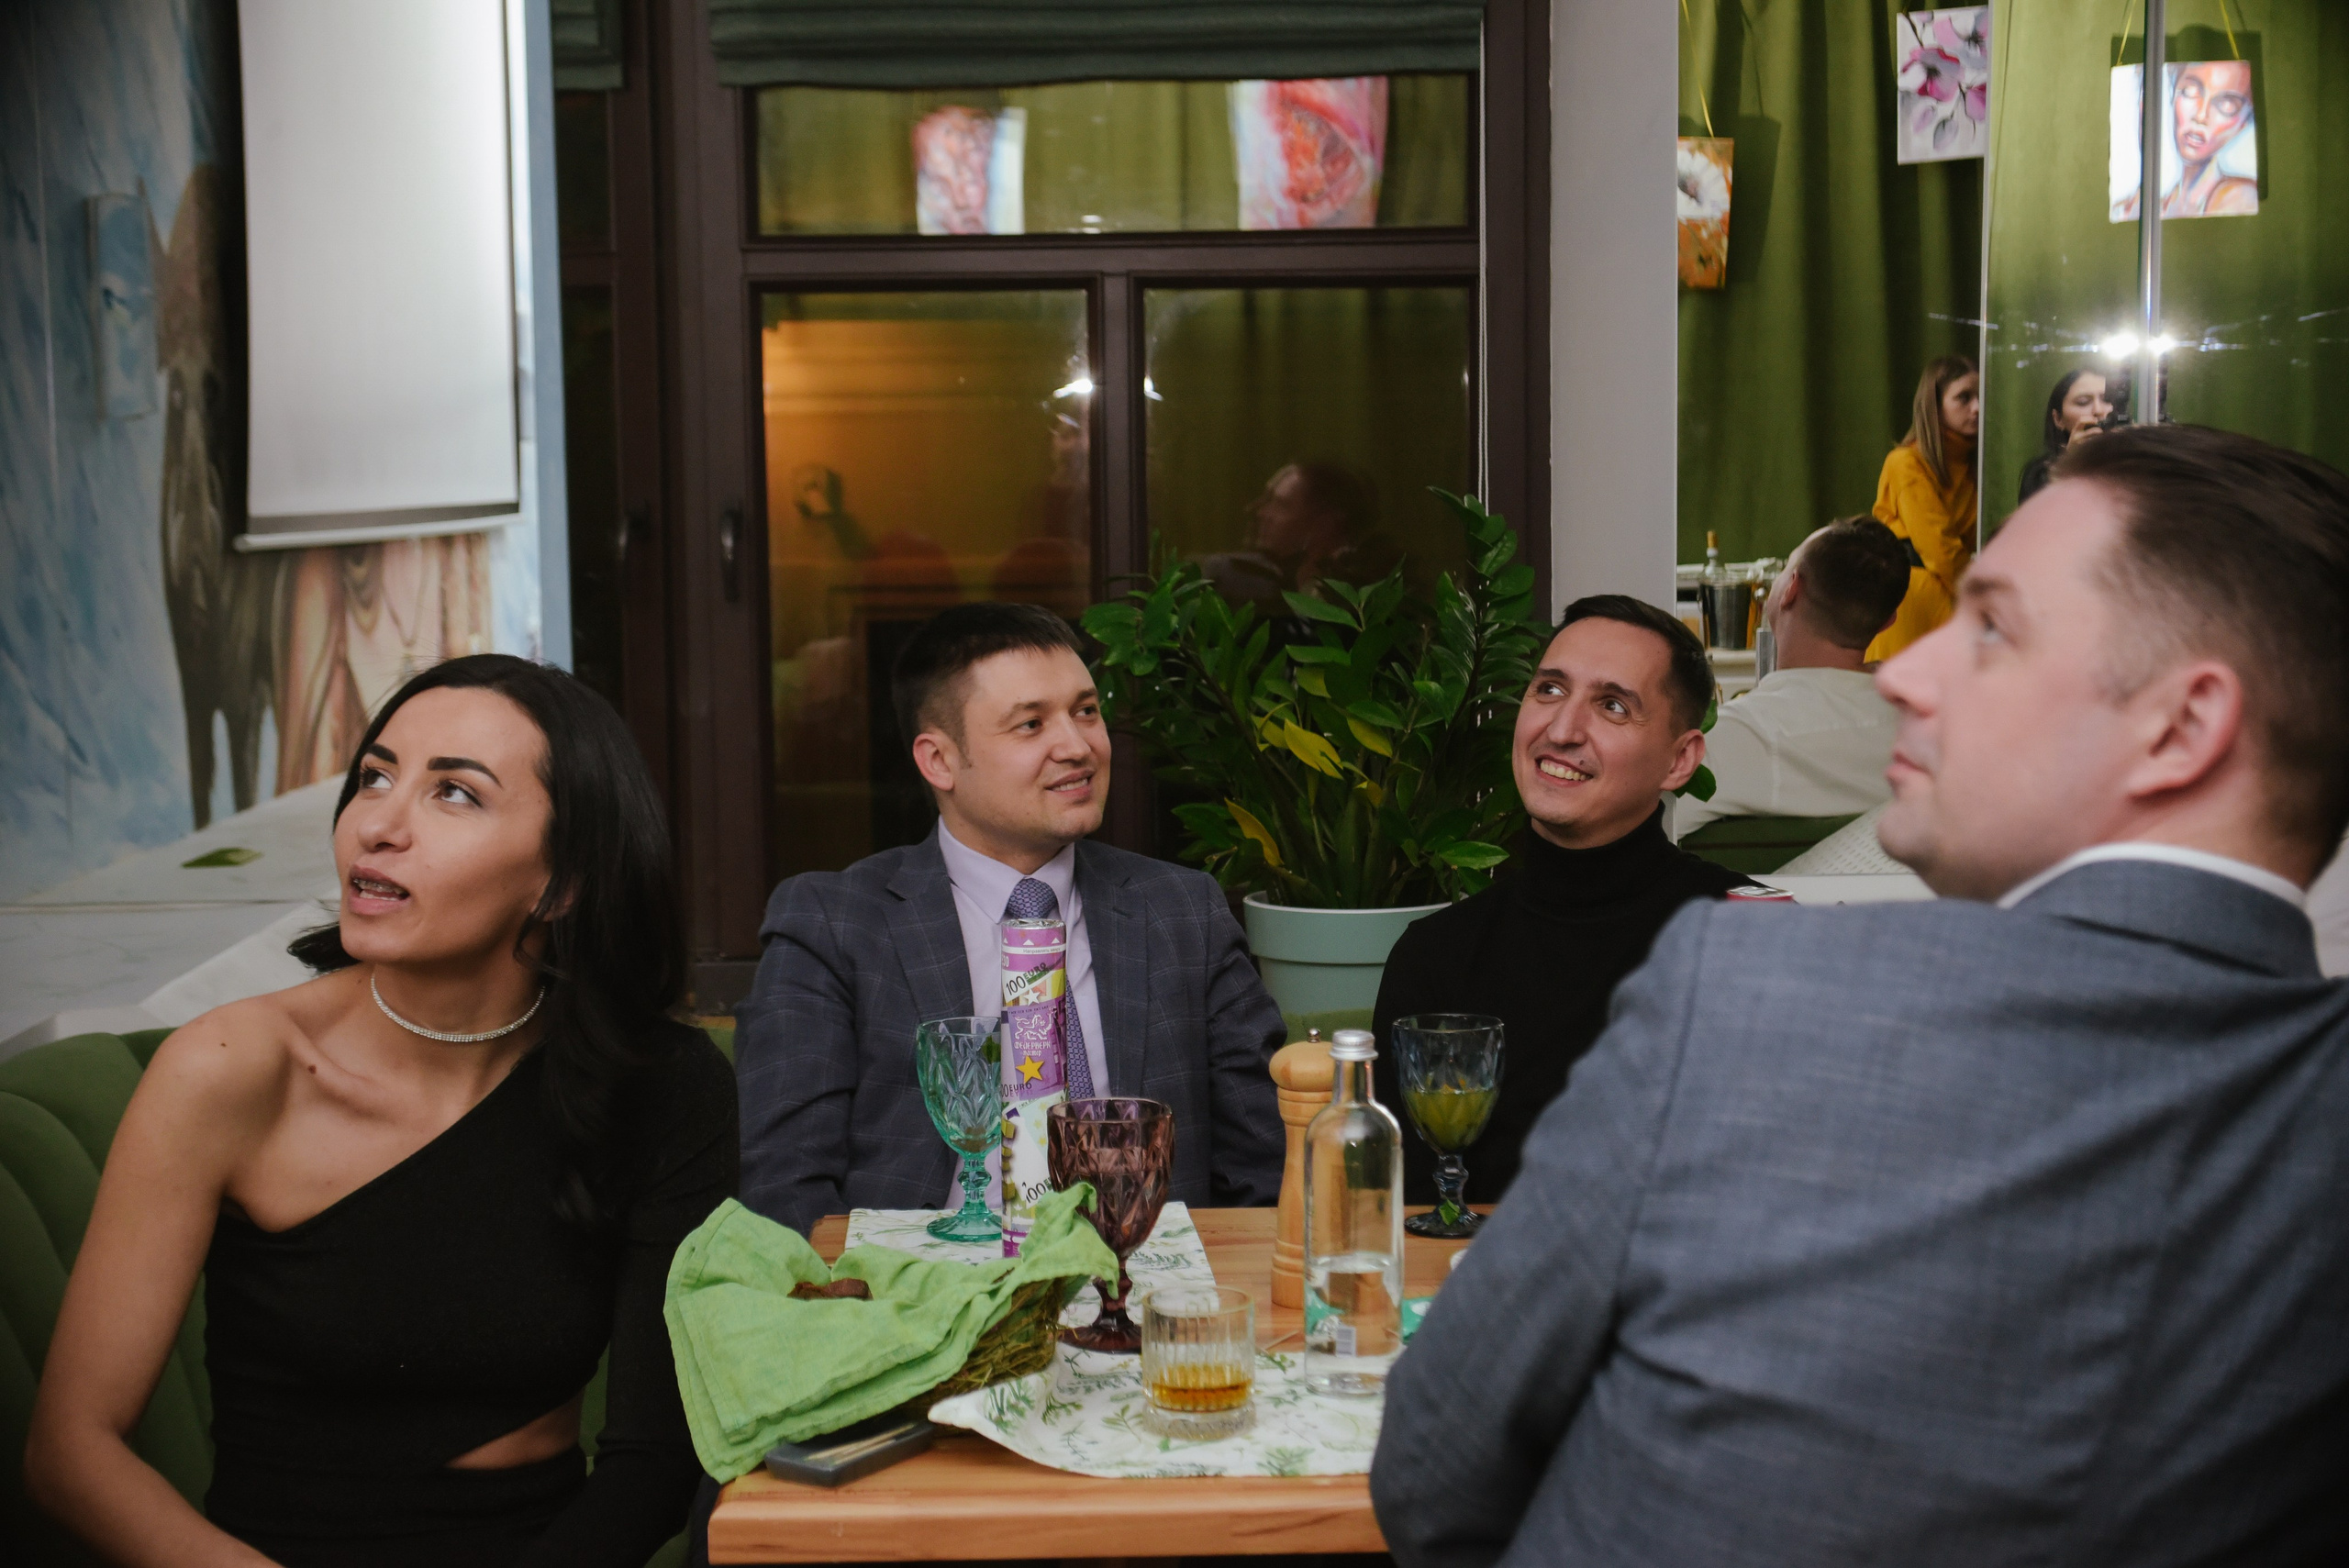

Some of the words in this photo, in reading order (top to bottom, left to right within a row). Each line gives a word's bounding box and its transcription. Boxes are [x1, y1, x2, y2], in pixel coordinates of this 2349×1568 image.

[1006, 975, 1026, 995] 100
[1023, 962, 1047, 980] EURO
[1009, 1083, 1032, 1092] EURO
